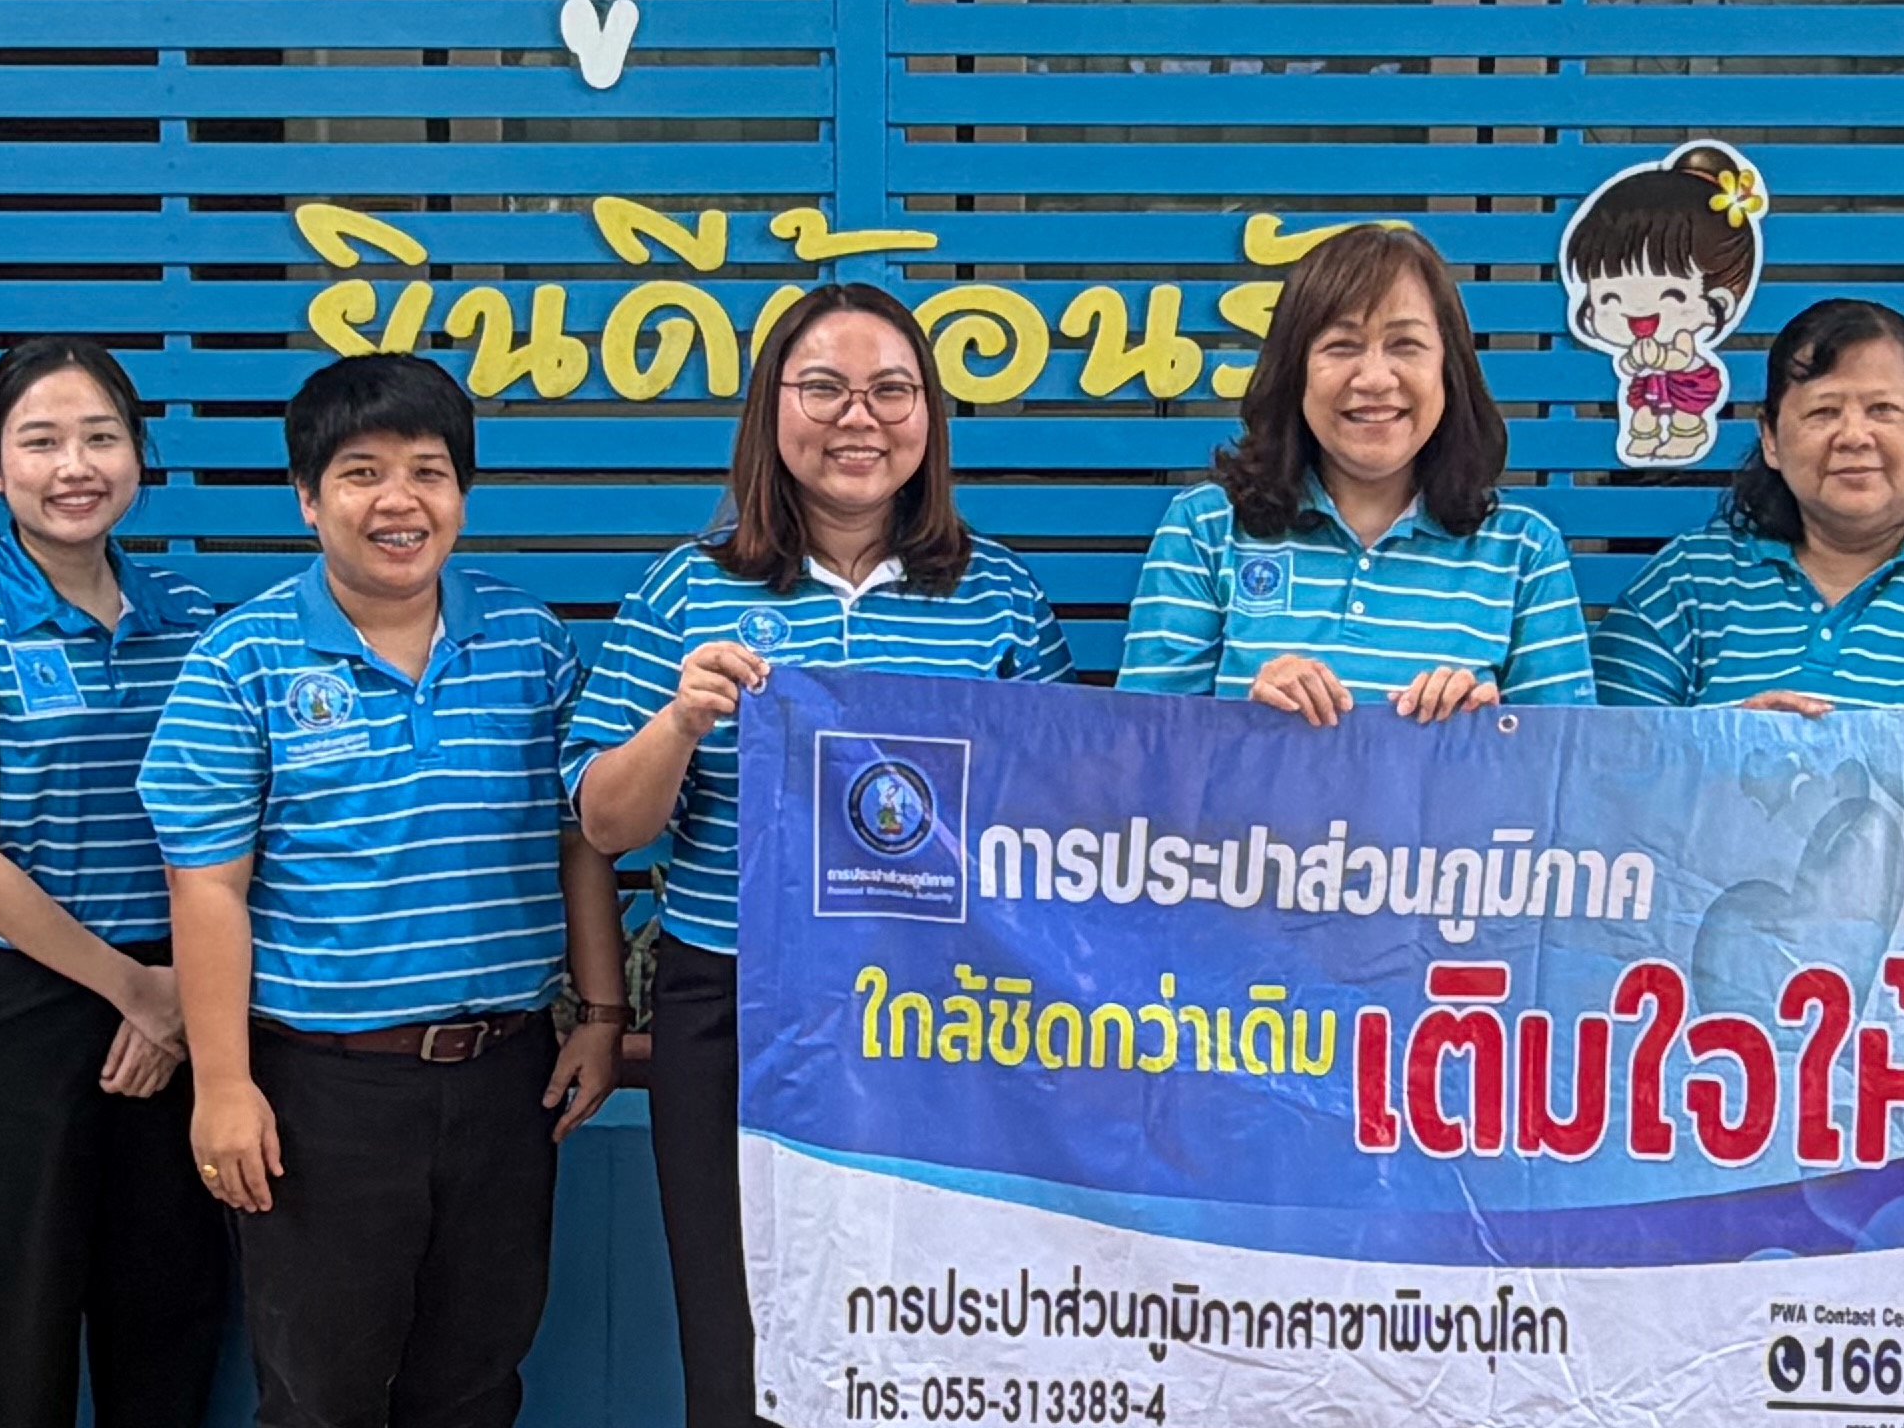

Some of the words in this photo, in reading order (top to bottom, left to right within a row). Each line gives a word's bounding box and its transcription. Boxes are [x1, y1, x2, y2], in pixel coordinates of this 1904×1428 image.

[978, 817, 1654, 945] การประปาส่วนภูมิภาค
[854, 963, 1337, 1077] ใกล้ชิดกว่าเดิม
[846, 1265, 1569, 1371] การประปาส่วนภูมิภาคสาขาพิษณุโลก
[1769, 1302, 1808, 1324] PWA
[1814, 1304, 1876, 1327] Contact
[846, 1366, 909, 1423] โทร.
[922, 1376, 1168, 1427] 055-313383-4
